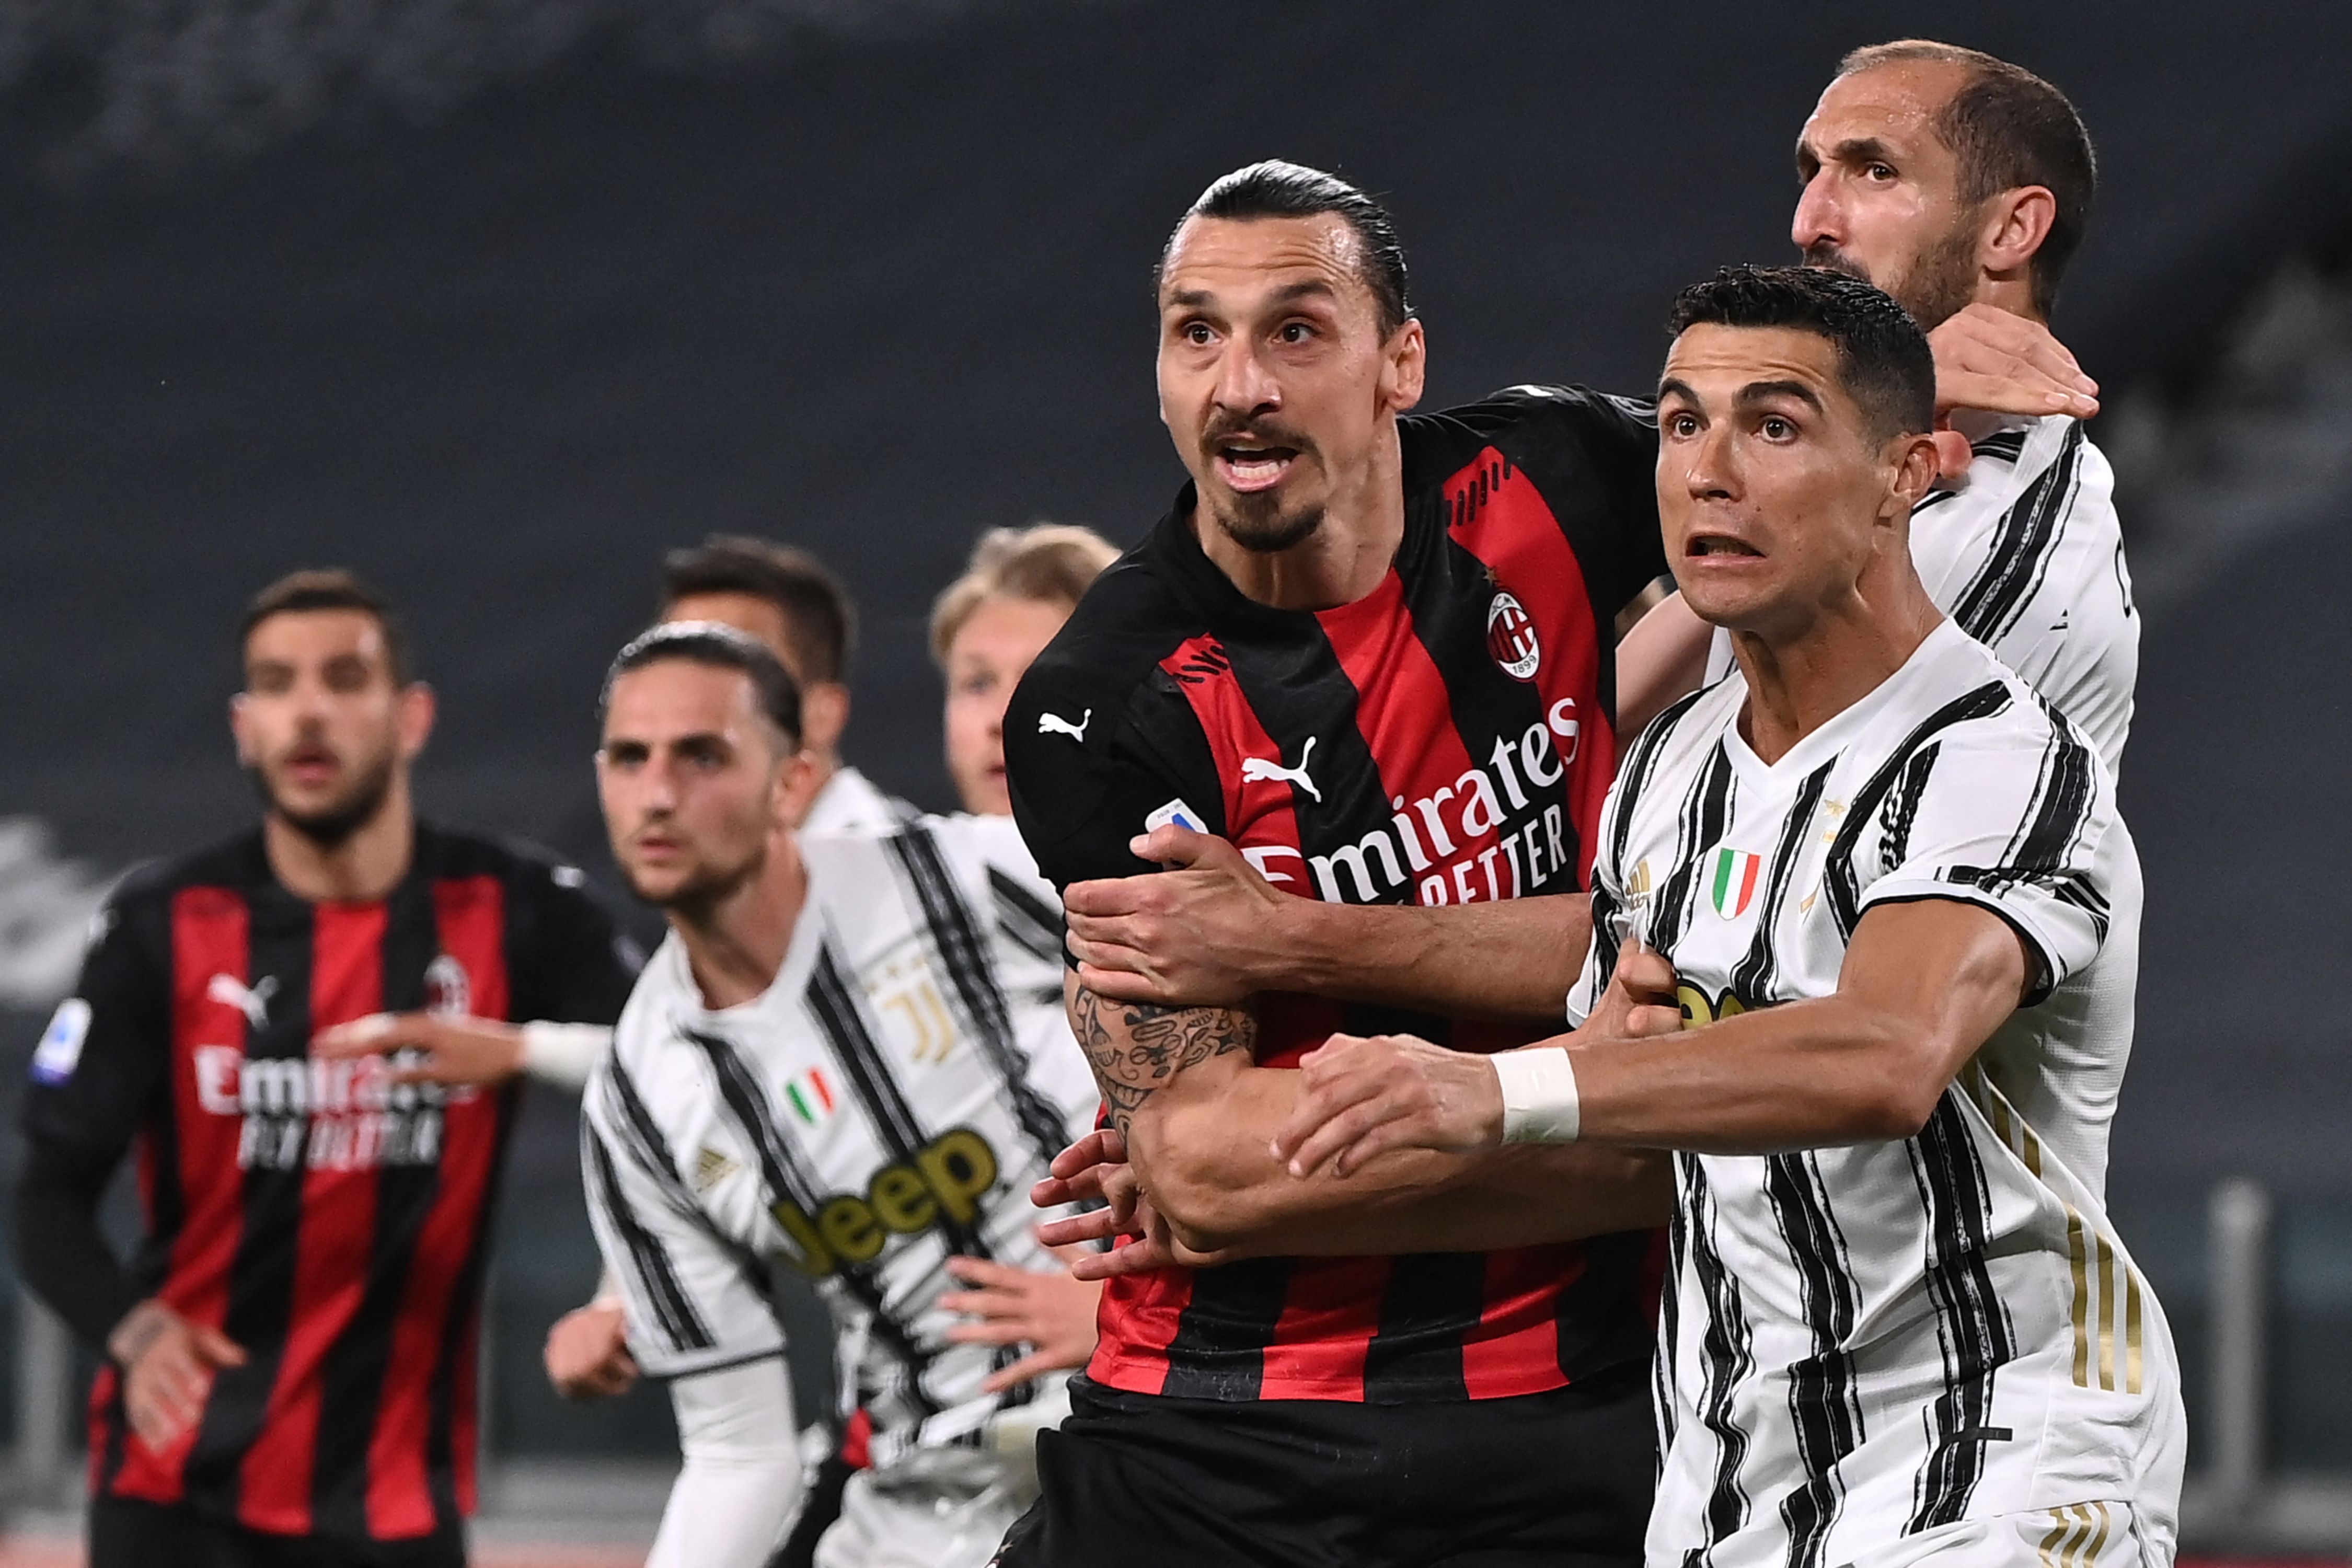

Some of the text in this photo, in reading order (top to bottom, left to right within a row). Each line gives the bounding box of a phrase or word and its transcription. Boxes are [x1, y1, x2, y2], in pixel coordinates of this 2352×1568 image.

[1512, 654, 1537, 674] 1899
[1239, 698, 1579, 903] Emirates
[769, 1127, 997, 1276] Jeep
